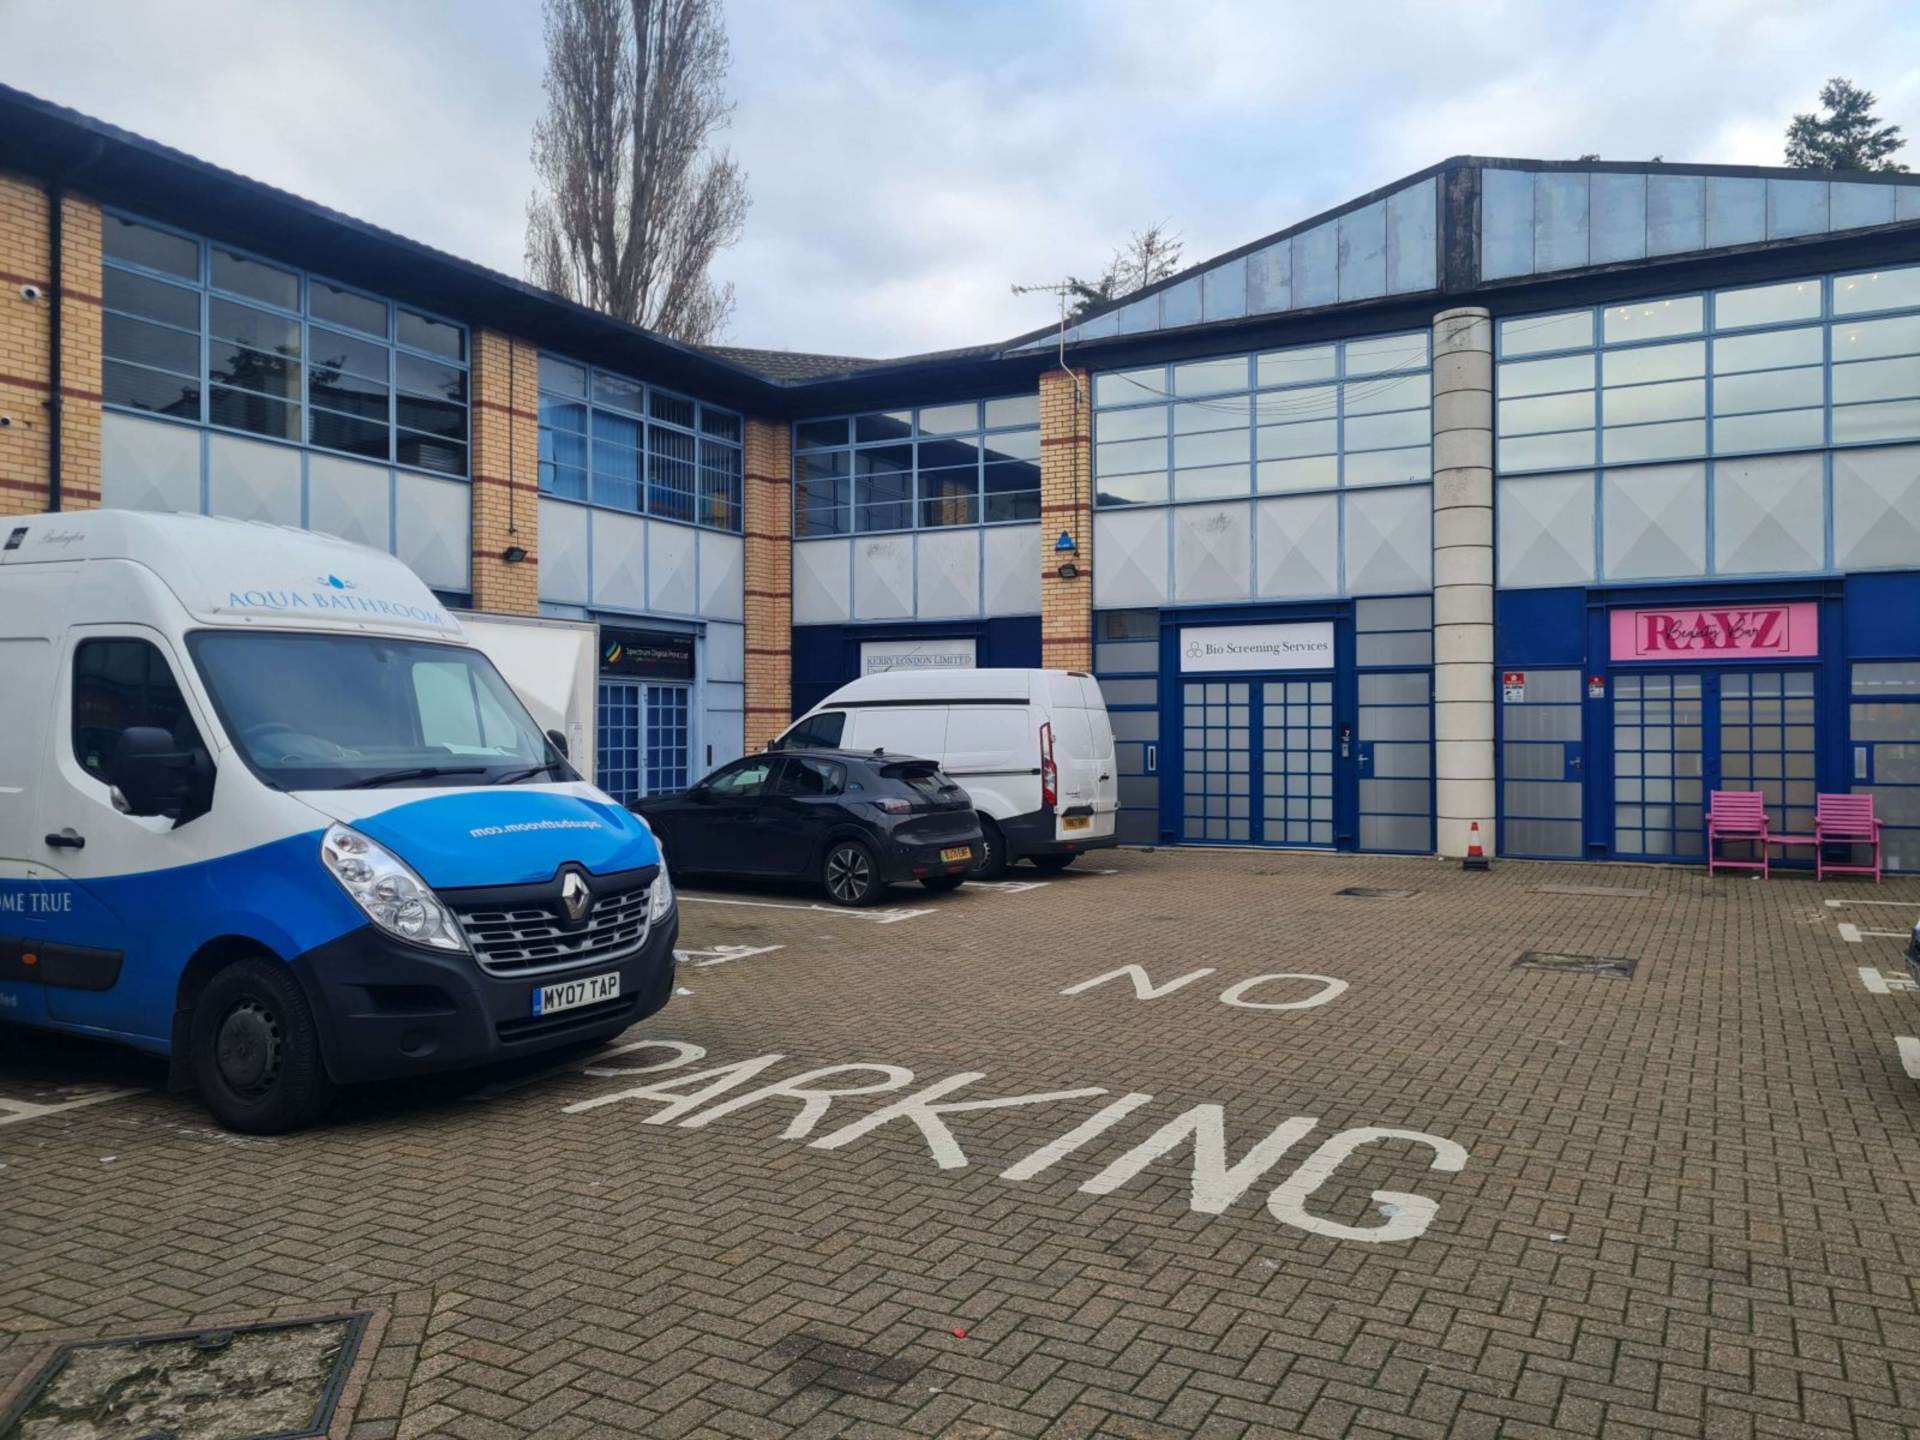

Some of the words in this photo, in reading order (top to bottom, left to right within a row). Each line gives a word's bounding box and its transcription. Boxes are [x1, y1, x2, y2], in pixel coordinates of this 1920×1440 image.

[229, 591, 308, 610] AQUA
[312, 593, 443, 626] BATHROOM
[1643, 611, 1783, 651] RAYZ
[1666, 619, 1721, 641] Beauty
[1728, 617, 1761, 640] Bar
[867, 655, 895, 666] KERRY
[896, 655, 933, 665] LONDON
[934, 654, 972, 665] LIMITED
[1205, 643, 1224, 655] Bio
[1226, 643, 1280, 656] Screening
[1282, 641, 1329, 652] Services
[0, 893, 25, 912] ME
[30, 892, 73, 912] TRUE
[544, 983, 585, 1010] MY07
[590, 976, 617, 999] TAP
[1058, 963, 1350, 1010] NO
[560, 1039, 1470, 1243] PARKING
